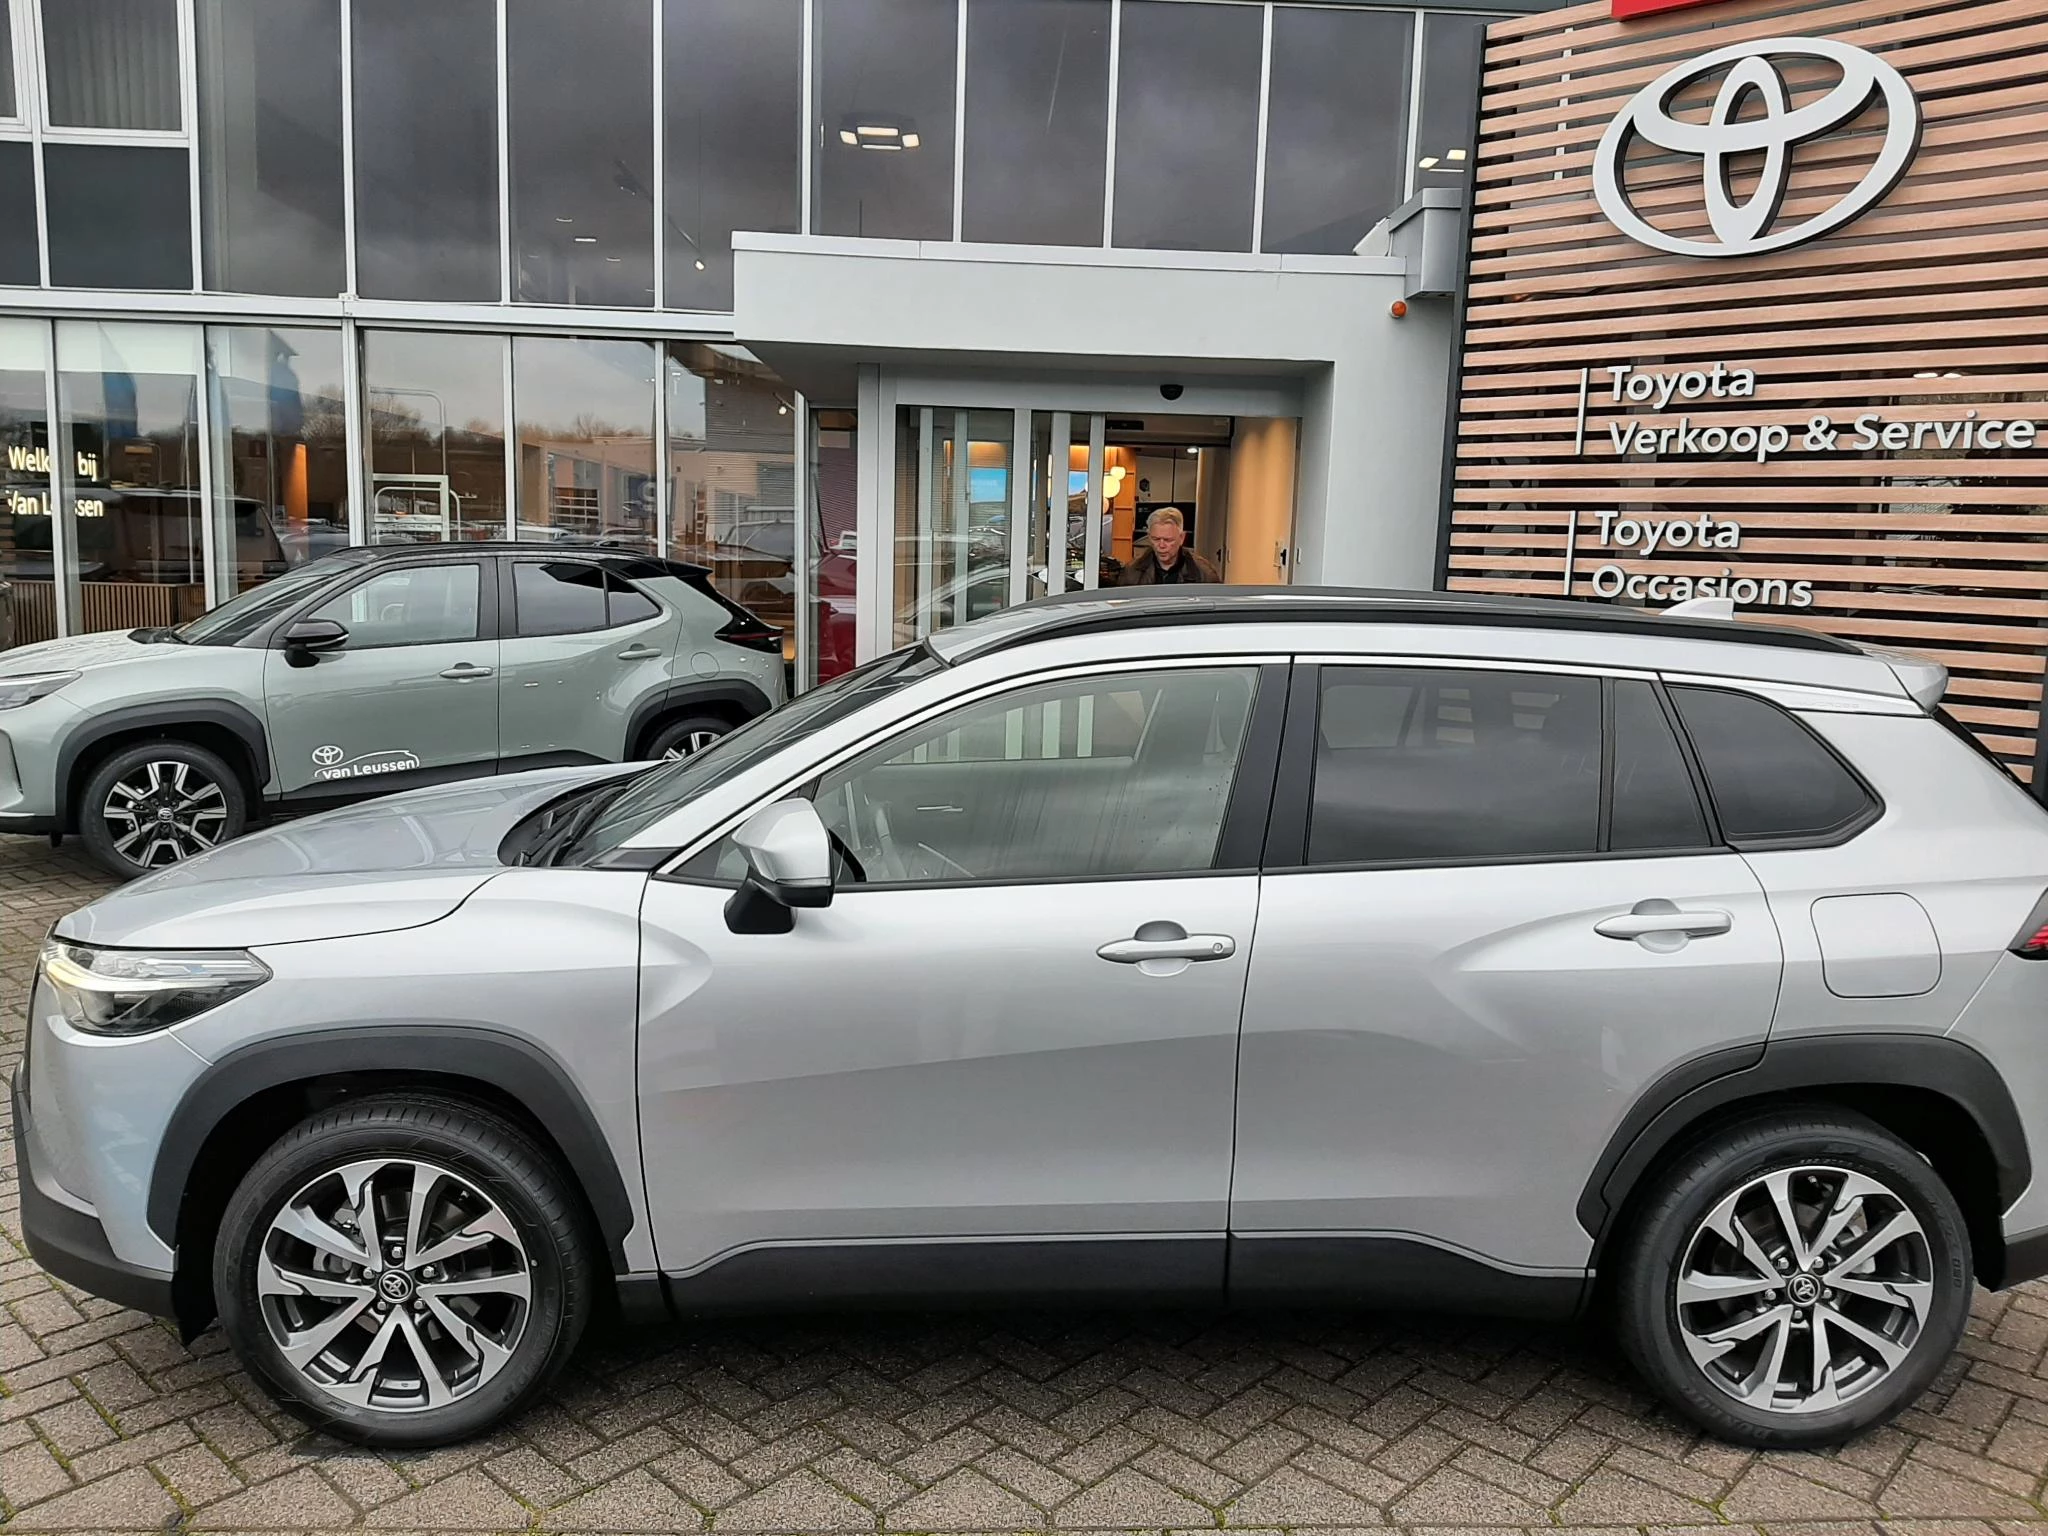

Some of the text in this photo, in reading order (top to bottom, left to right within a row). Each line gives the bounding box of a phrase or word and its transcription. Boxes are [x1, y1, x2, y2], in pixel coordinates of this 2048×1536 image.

[1607, 362, 1755, 410] Toyota
[1609, 409, 2036, 464] Verkoop & Service
[8, 445, 97, 482] Welk bij
[1594, 510, 1741, 556] Toyota
[1591, 564, 1814, 607] Occasions
[322, 759, 416, 780] van Leussen
